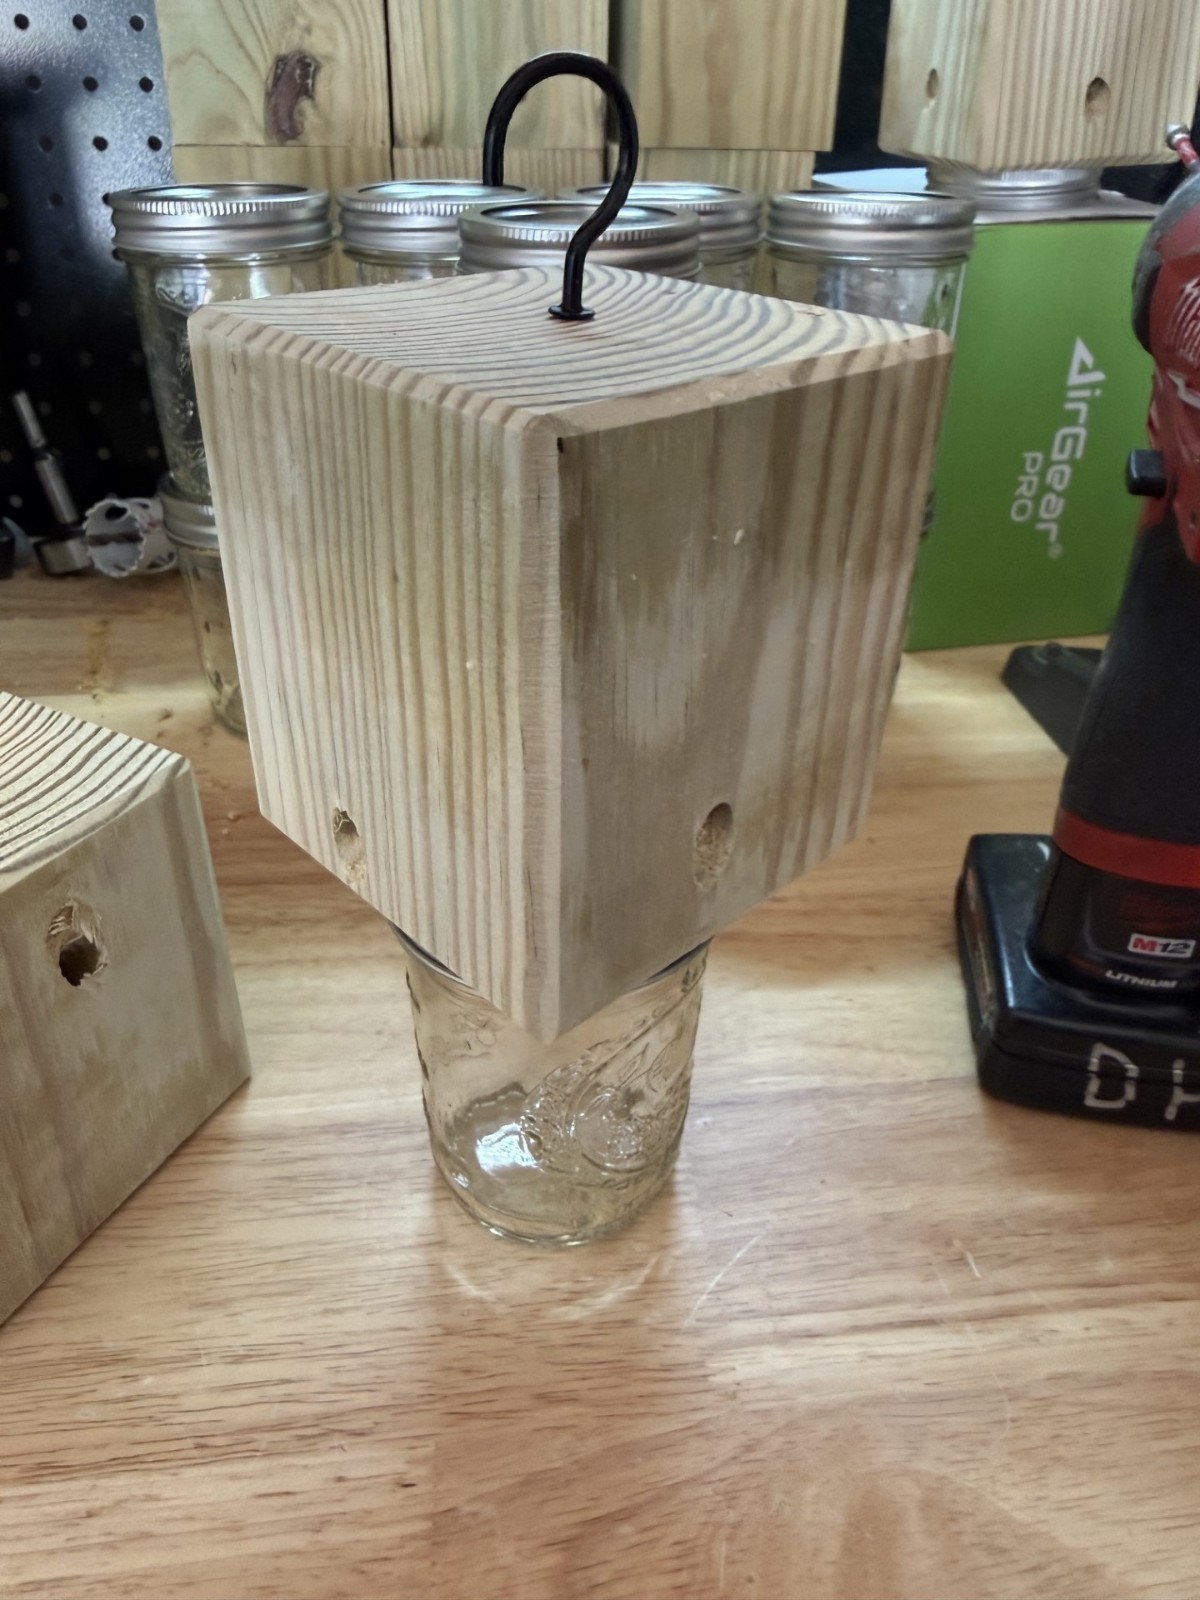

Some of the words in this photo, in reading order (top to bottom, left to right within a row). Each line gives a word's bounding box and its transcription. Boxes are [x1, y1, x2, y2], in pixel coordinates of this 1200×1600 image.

[1010, 451, 1044, 523] PRO
[1131, 936, 1192, 955] M12
[1105, 969, 1178, 988] LITHIUM
